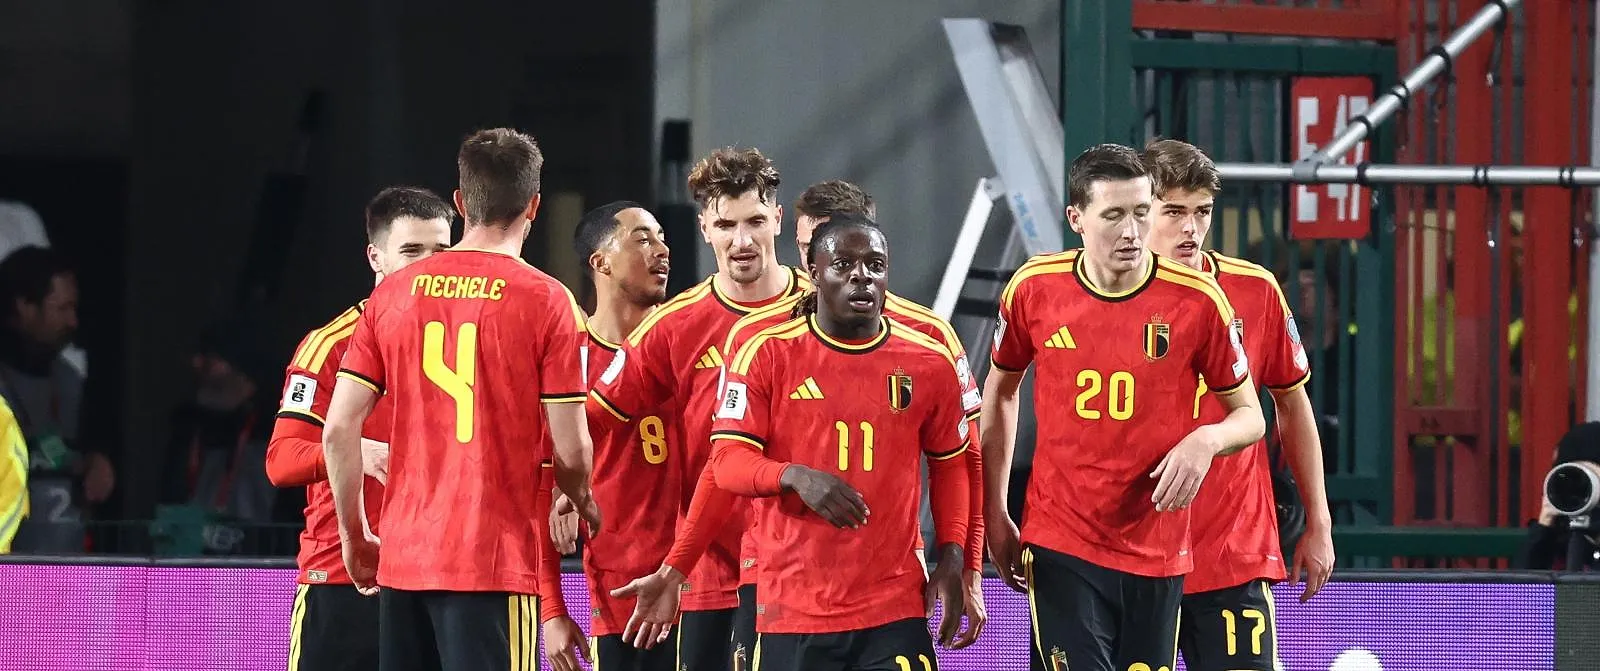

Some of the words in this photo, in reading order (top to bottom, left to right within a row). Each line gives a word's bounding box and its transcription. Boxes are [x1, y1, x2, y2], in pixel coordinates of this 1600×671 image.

[411, 274, 507, 301] MECHELE
[422, 320, 478, 444] 4
[1076, 369, 1135, 421] 20
[639, 415, 668, 465] 8
[835, 420, 875, 472] 11
[1221, 609, 1266, 656] 17
